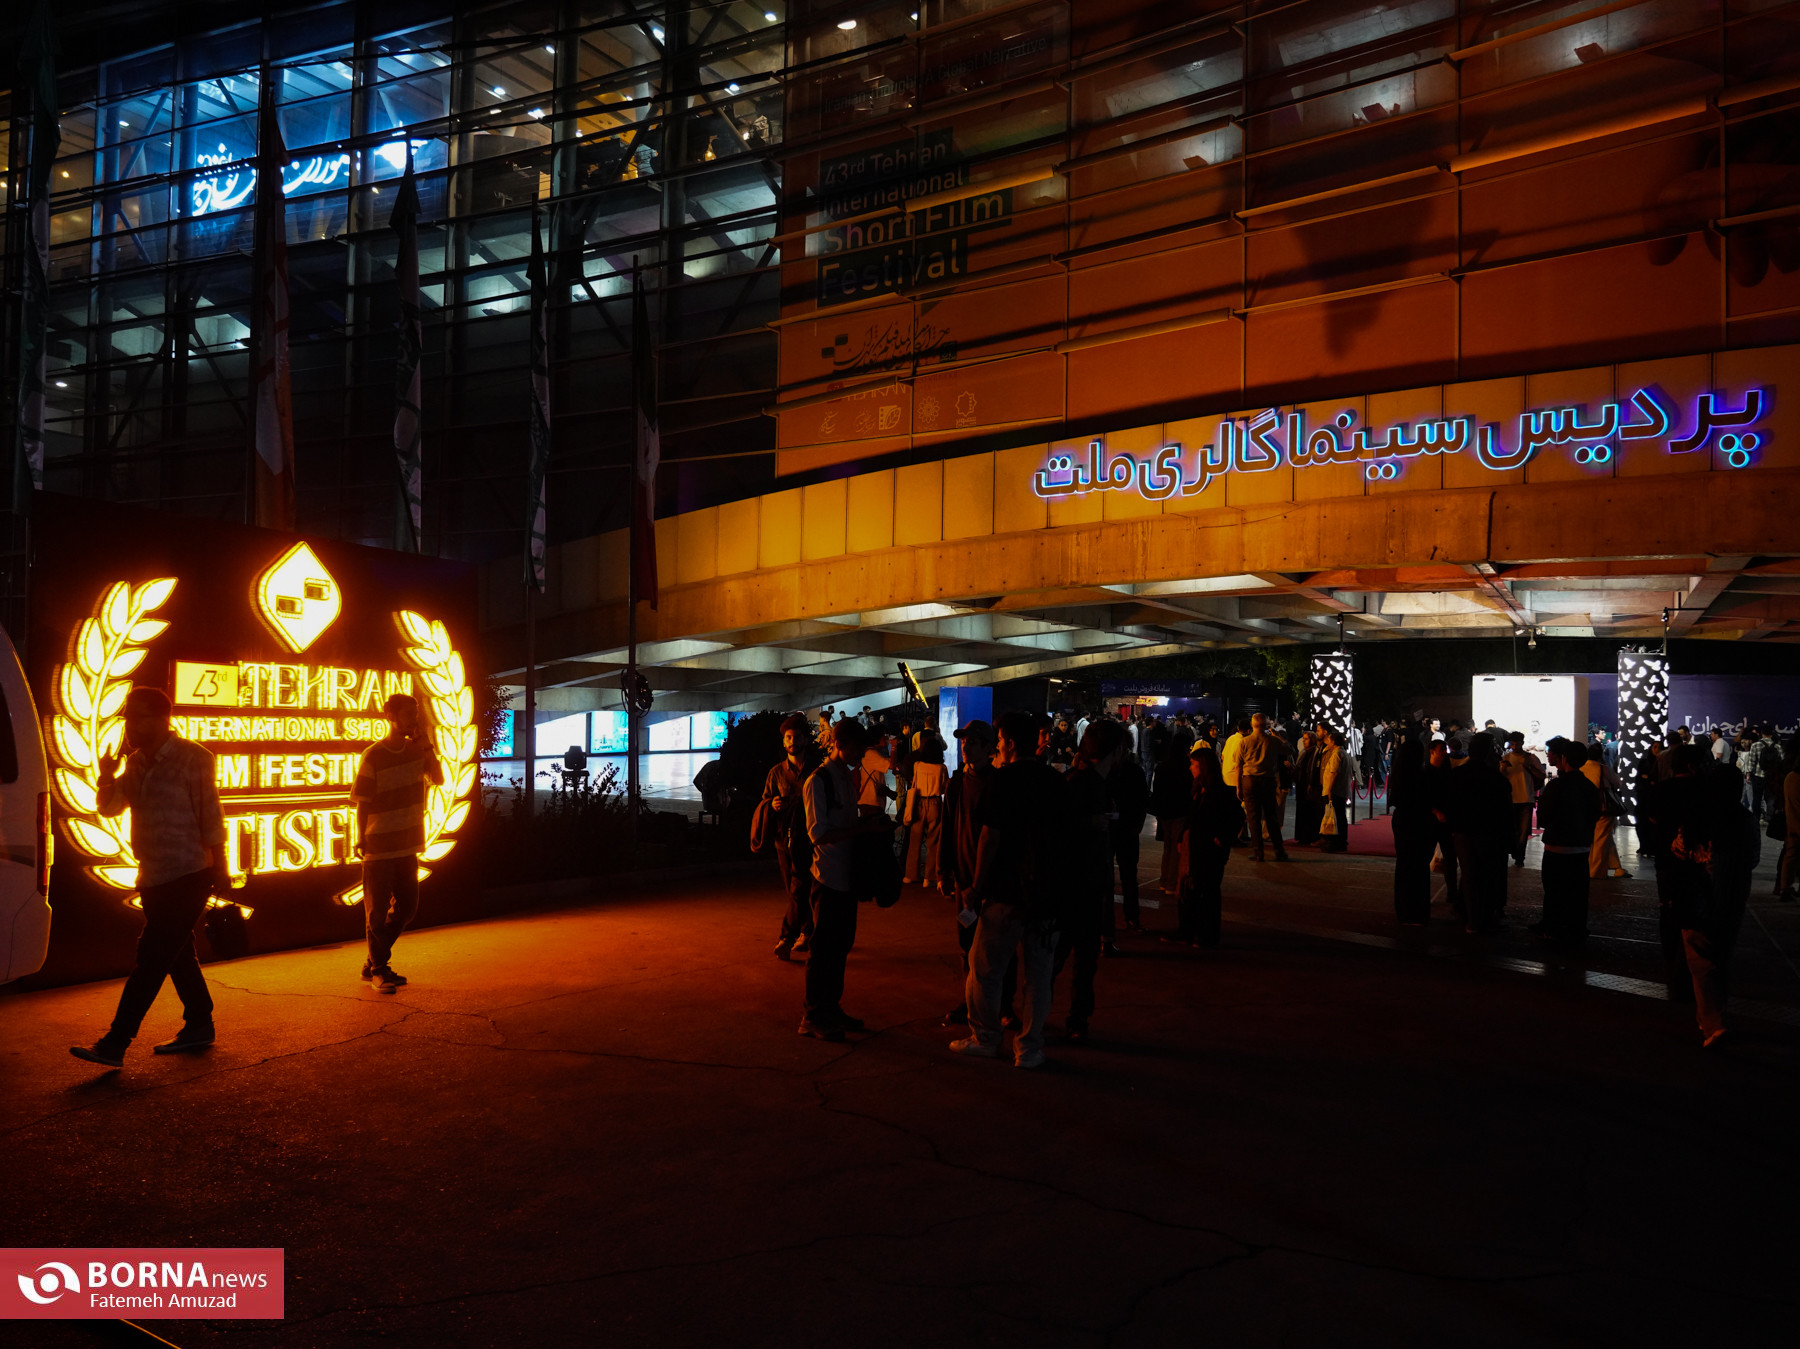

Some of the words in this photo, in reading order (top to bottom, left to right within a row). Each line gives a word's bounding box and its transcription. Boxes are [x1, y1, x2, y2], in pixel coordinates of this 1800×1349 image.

[938, 58, 980, 81] Global
[823, 165, 965, 218] International
[824, 157, 865, 186] 43rd
[870, 142, 947, 177] Tehran
[823, 211, 915, 253] Short
[925, 194, 1004, 233] Film
[821, 238, 960, 300] Festival
[1137, 407, 1281, 501] گالری
[1287, 412, 1468, 480] سینما
[1476, 388, 1763, 470] پردیس
[1033, 441, 1137, 498] ملت
[192, 669, 228, 705] 43rd
[169, 715, 341, 742] NTERNATIONAL
[344, 717, 391, 742] SHO
[260, 752, 363, 788] FESTI
